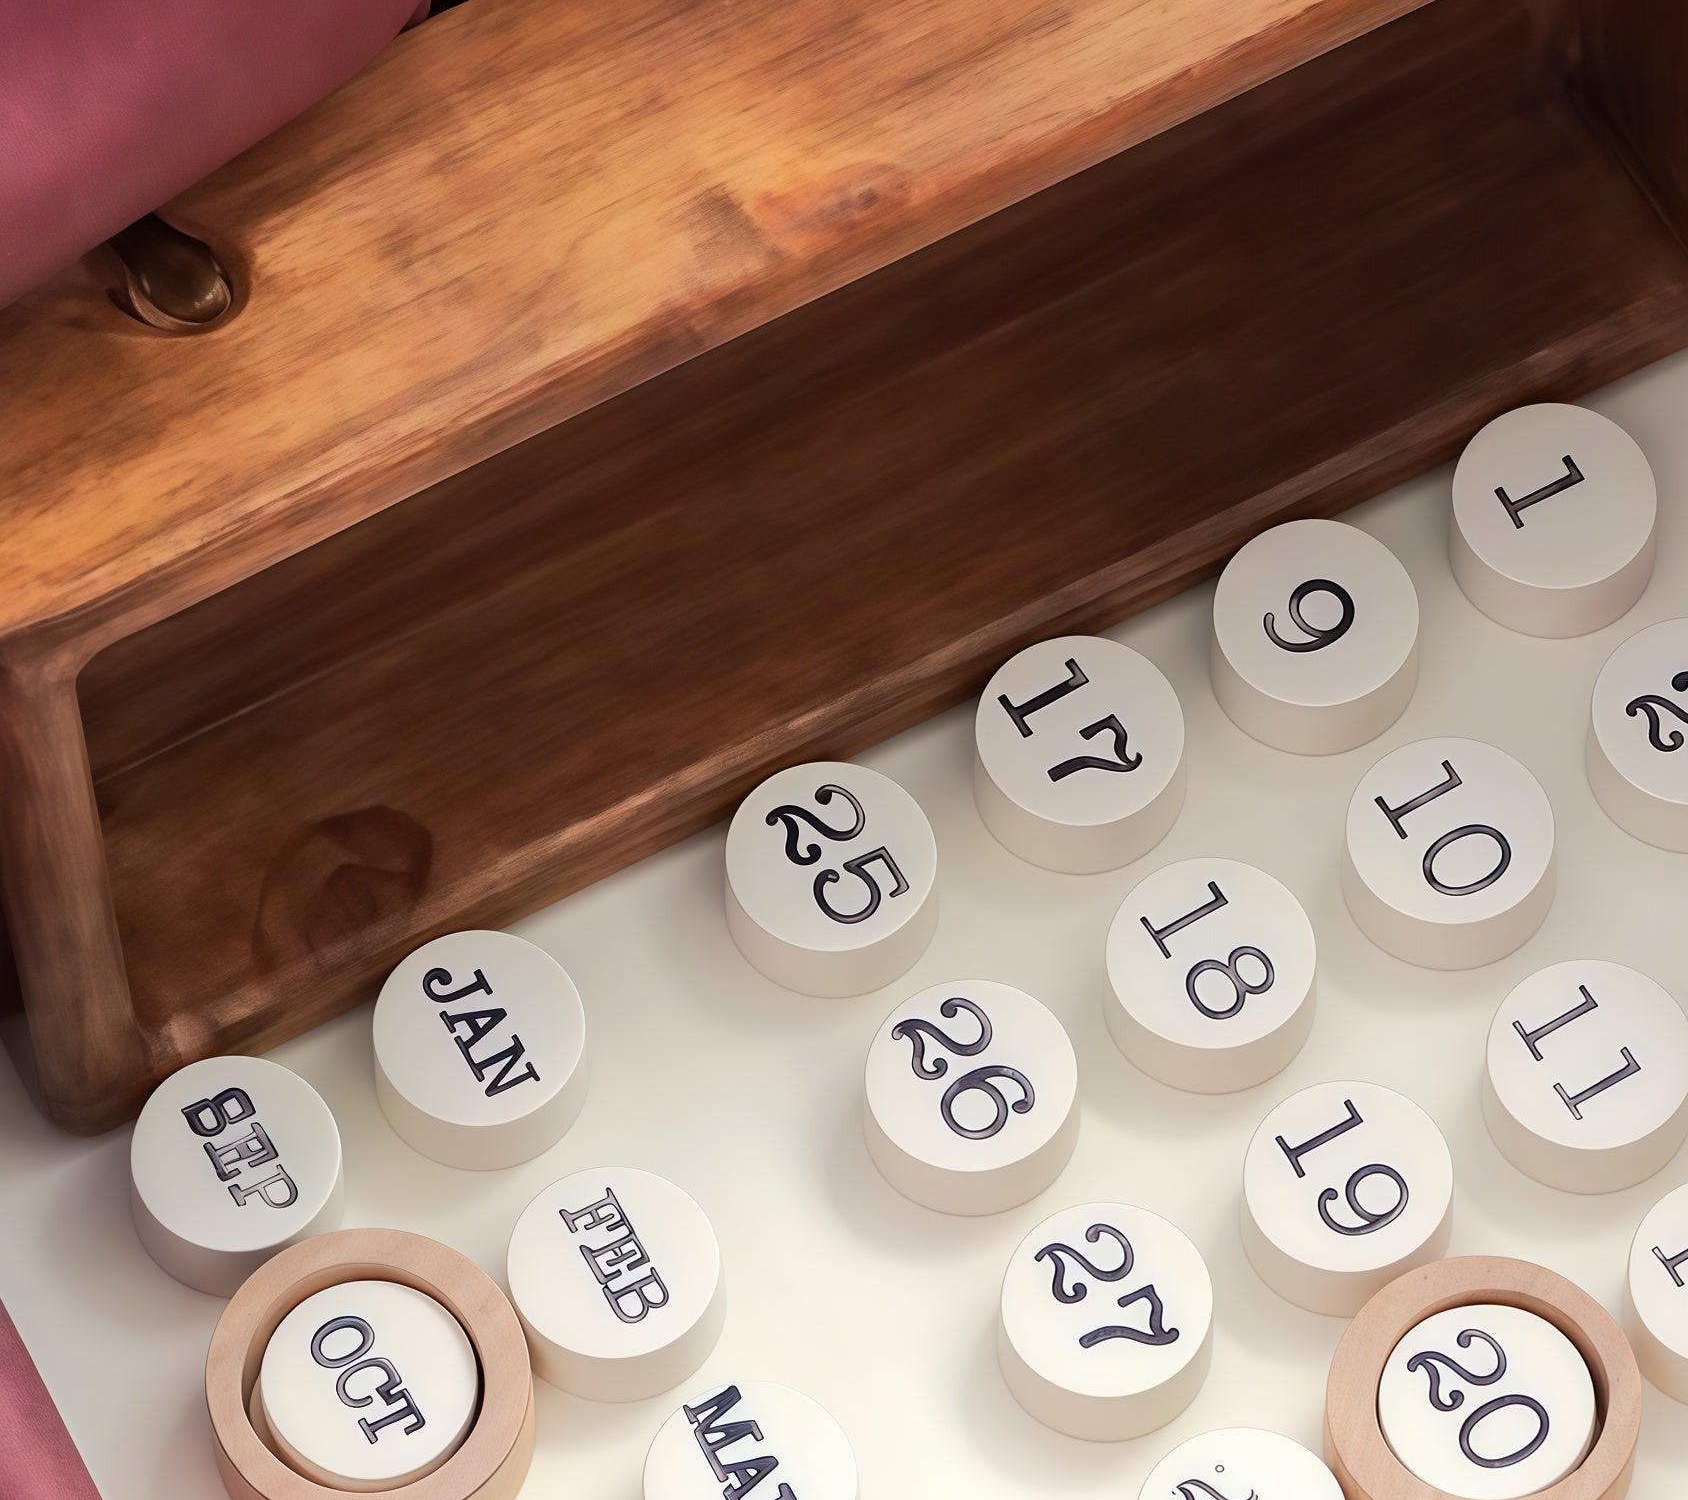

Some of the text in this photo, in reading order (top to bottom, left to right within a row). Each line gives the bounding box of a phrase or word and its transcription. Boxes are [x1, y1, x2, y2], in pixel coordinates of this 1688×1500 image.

[1494, 454, 1586, 529] 1
[1263, 578, 1356, 654] 9
[997, 657, 1143, 783] 17
[765, 784, 910, 924] 25
[1373, 759, 1512, 897] 10
[1139, 880, 1275, 1021] 18
[422, 966, 541, 1098] JAN
[892, 997, 1036, 1141] 26
[1511, 984, 1642, 1121] 11
[1275, 1099, 1410, 1237] 19
[558, 1187, 670, 1325] FEB
[1033, 1222, 1181, 1350] 27
[309, 1315, 427, 1445] OCT
[1406, 1328, 1551, 1469] 20
